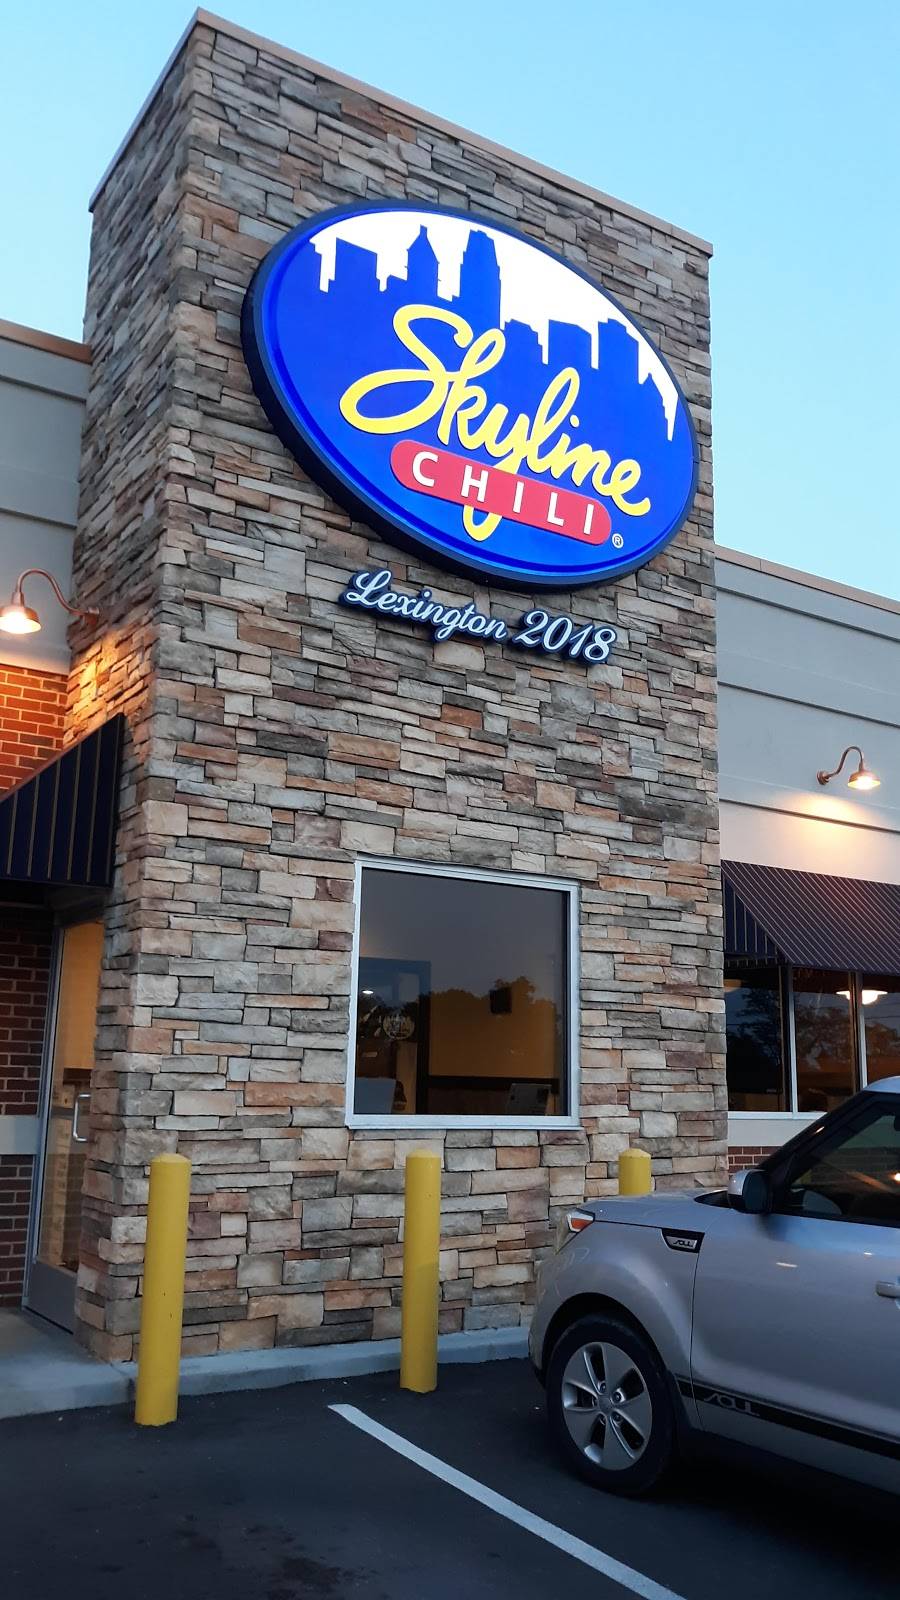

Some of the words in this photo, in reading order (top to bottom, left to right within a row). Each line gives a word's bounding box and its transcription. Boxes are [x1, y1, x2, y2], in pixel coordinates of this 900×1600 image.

[339, 304, 651, 541] Skyline
[412, 451, 594, 535] CHILI
[346, 570, 507, 640] Lexington
[515, 610, 616, 661] 2018
